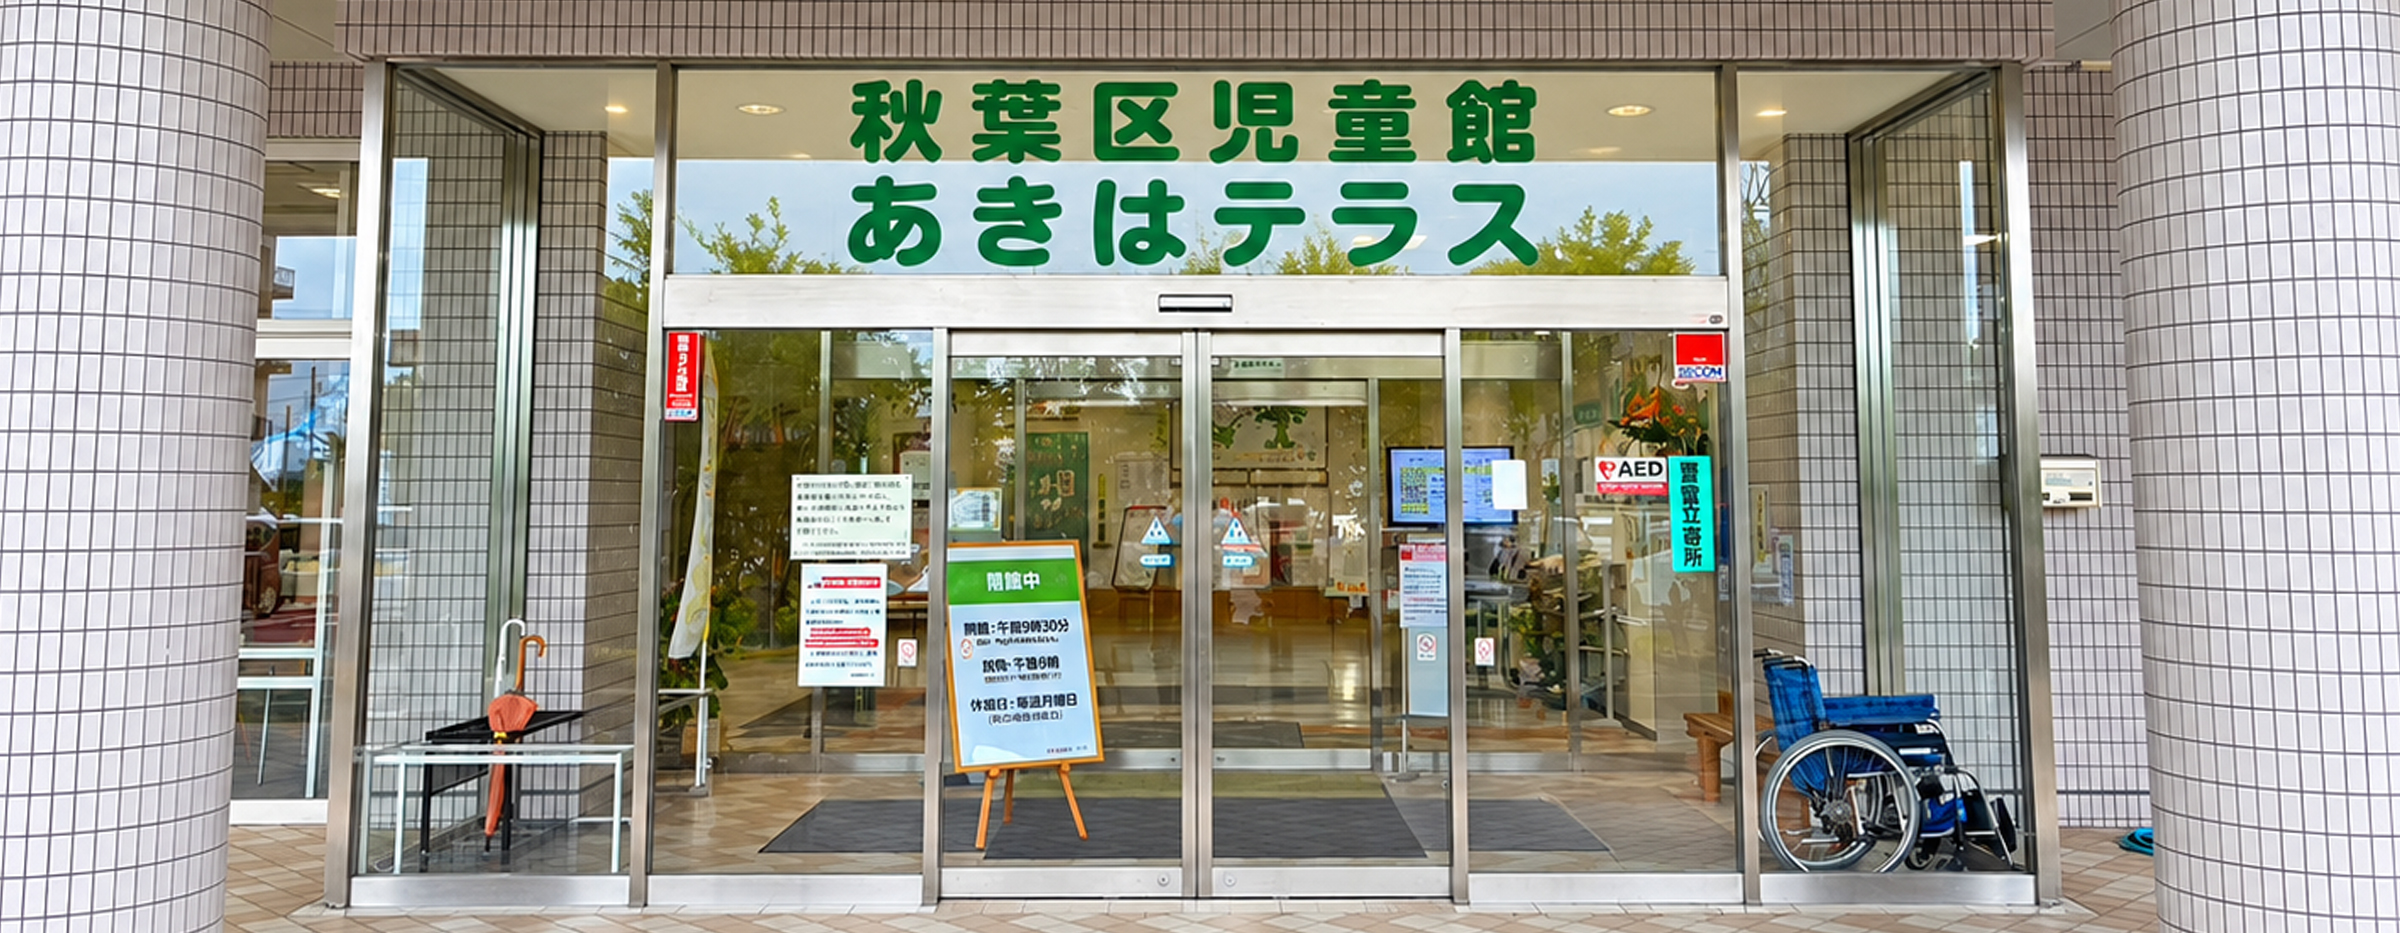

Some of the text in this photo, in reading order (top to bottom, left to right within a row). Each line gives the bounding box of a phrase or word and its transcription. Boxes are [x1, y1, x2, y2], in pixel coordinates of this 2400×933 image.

[852, 80, 1536, 163] 秋葉区児童館
[849, 177, 1538, 266] あきはテラス
[1618, 460, 1663, 477] AED
